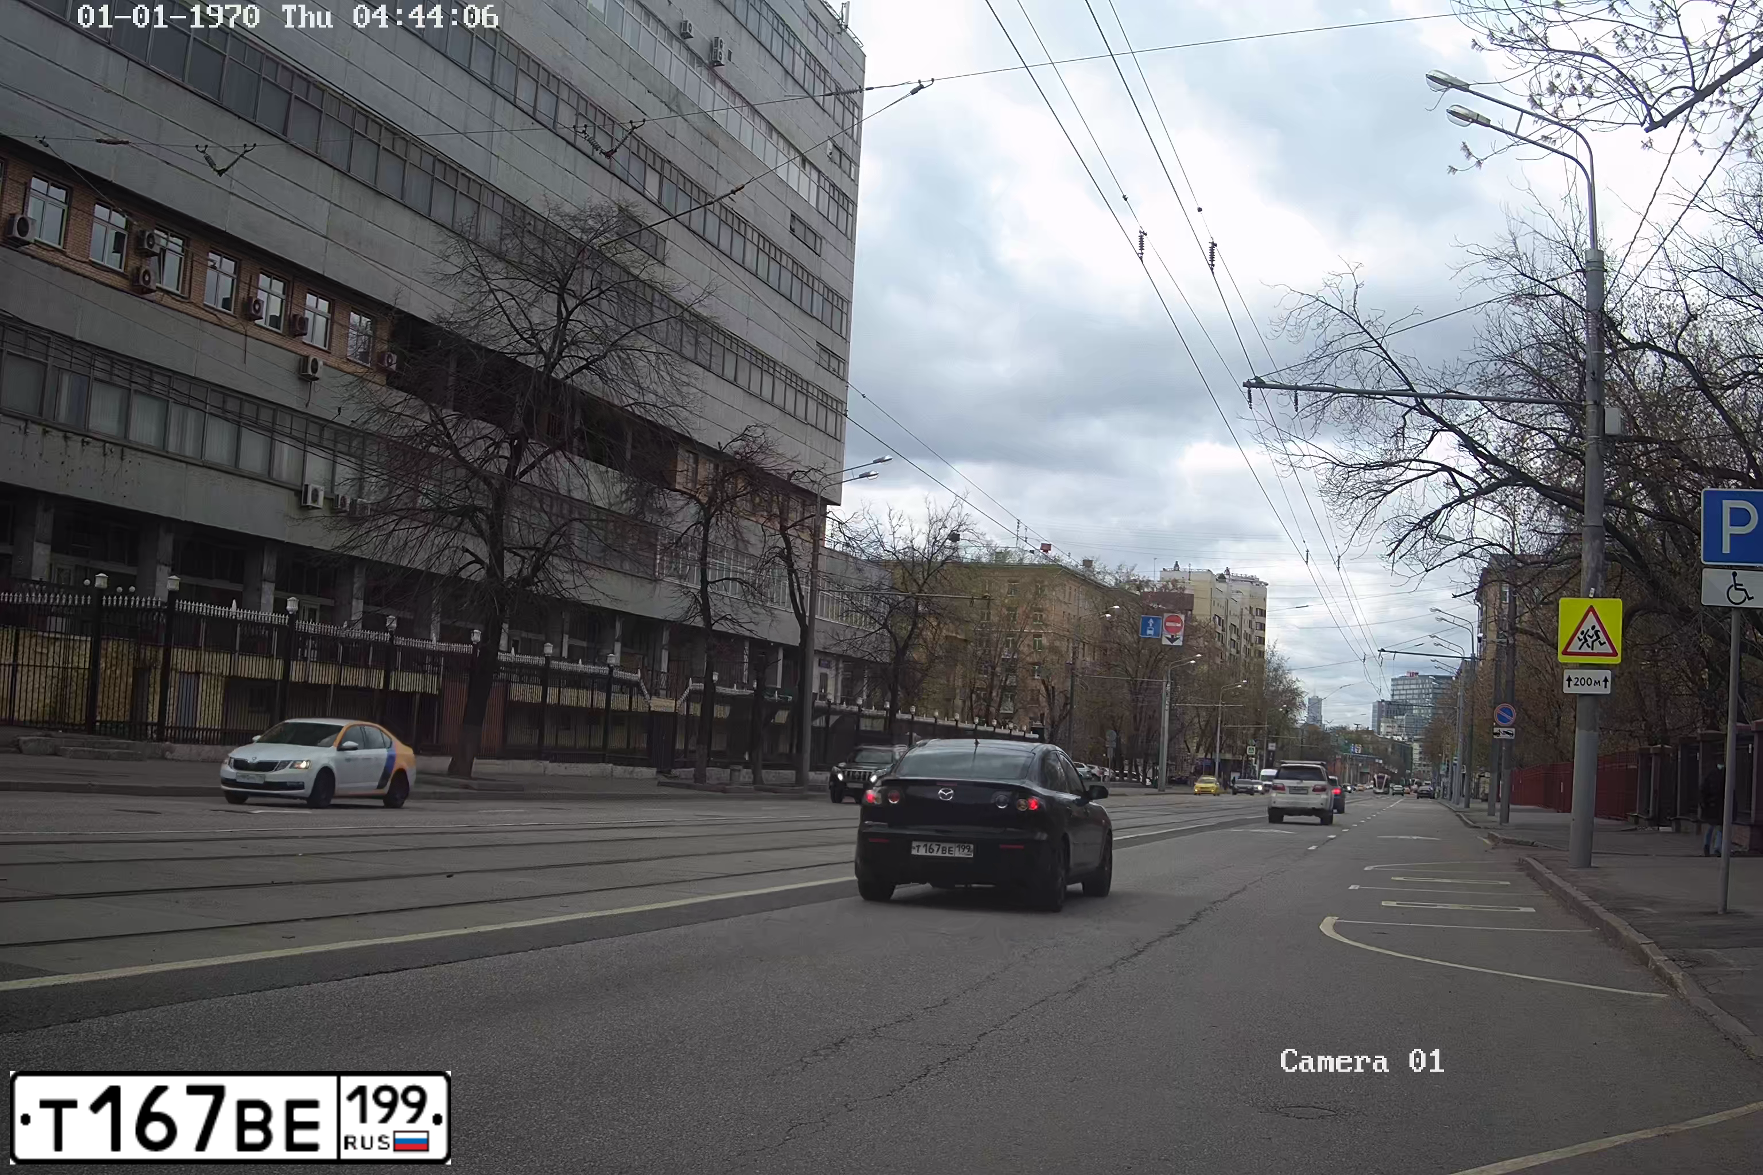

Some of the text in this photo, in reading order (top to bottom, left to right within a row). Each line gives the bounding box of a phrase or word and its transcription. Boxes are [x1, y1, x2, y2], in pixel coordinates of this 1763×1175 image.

[1722, 499, 1759, 554] P
[915, 843, 971, 855] Т167ВЕ 199
